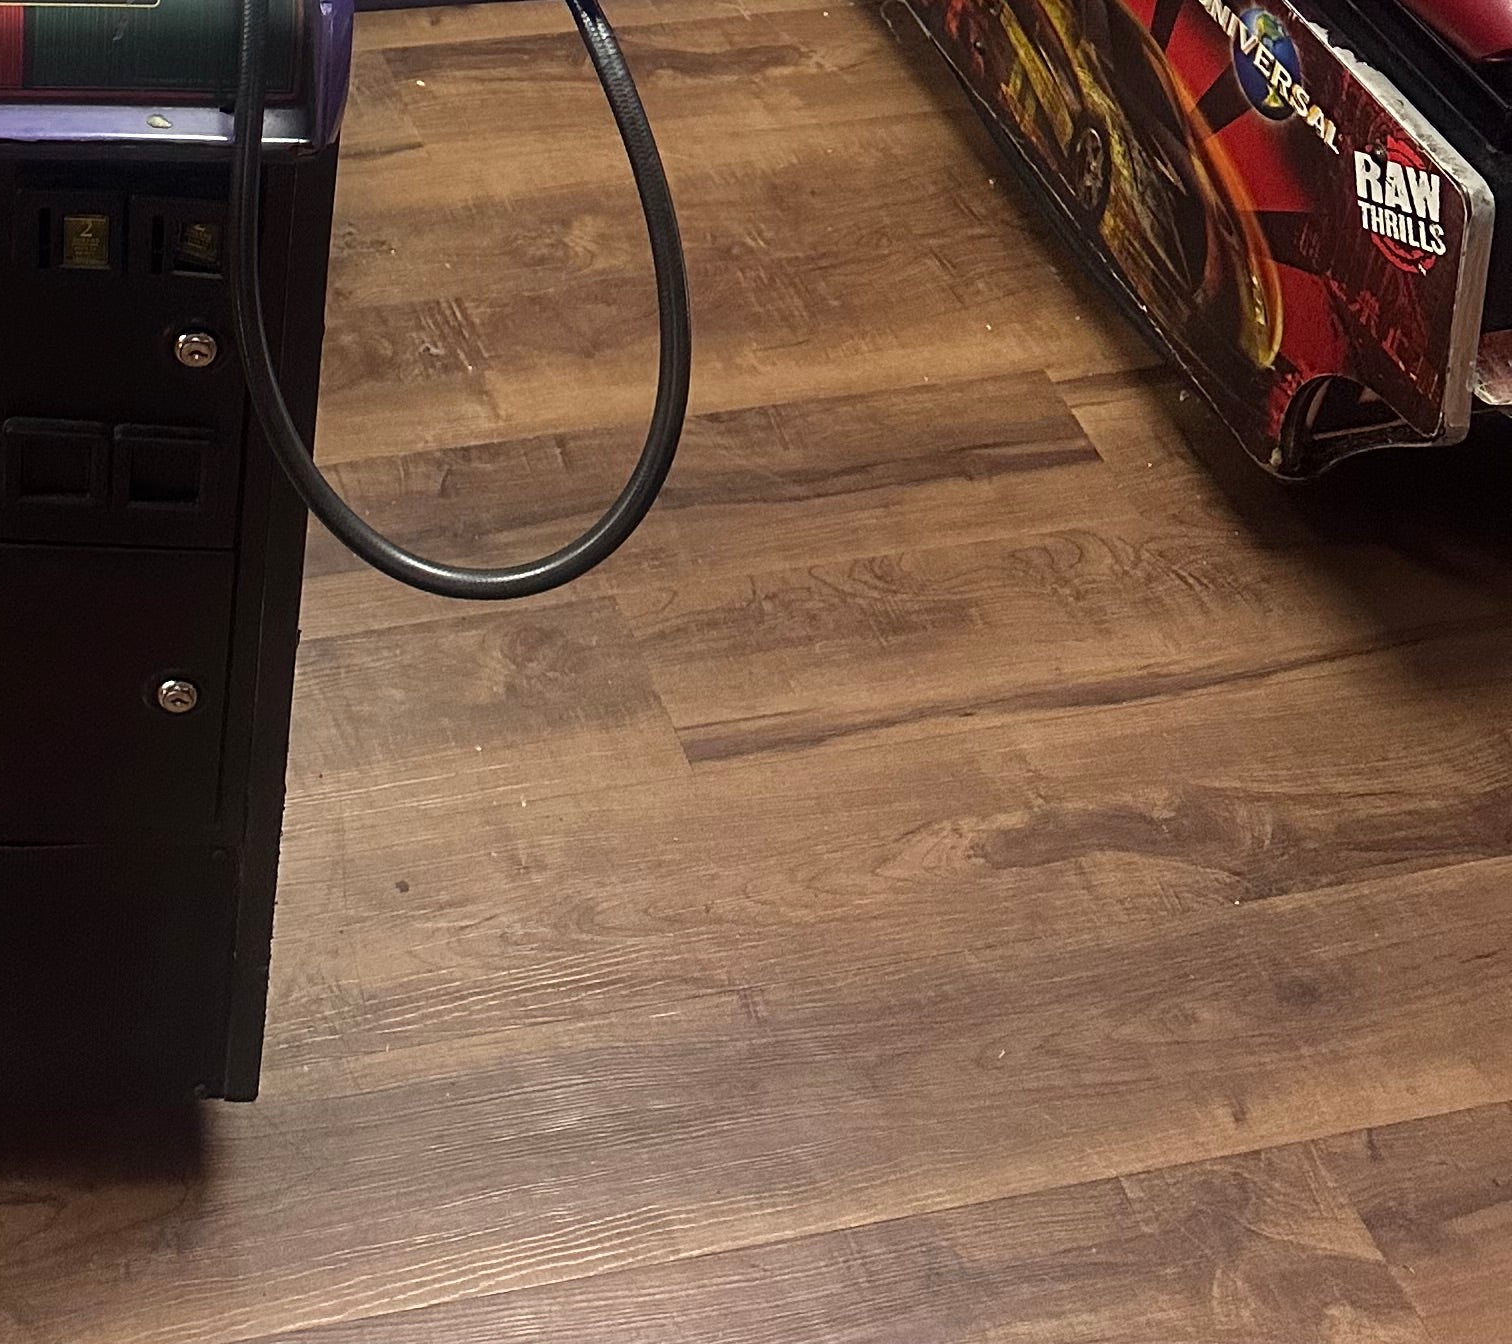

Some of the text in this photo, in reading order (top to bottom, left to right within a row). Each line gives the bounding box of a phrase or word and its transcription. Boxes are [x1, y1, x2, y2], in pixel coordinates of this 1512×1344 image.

[1354, 150, 1440, 223] RAW
[80, 222, 93, 237] 2
[1357, 199, 1446, 256] THRILLS
